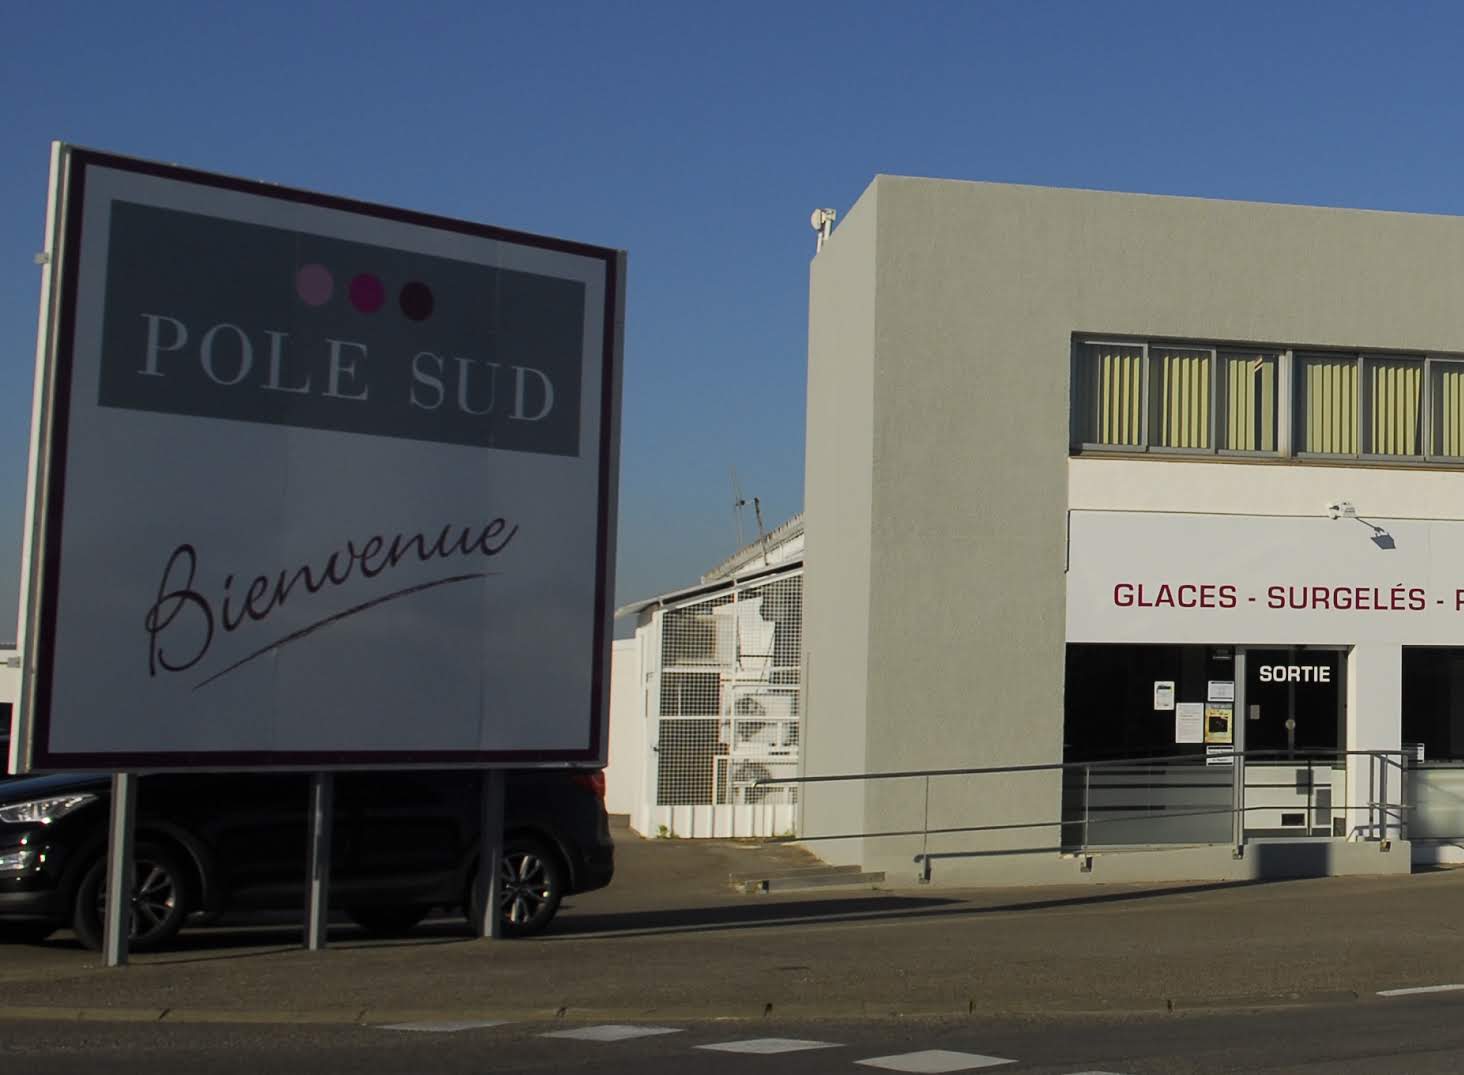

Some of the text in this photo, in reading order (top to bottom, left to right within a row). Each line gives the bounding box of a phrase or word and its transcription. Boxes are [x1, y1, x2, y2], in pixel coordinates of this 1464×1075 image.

[137, 313, 555, 422] POLE SUD
[145, 517, 518, 677] Bienvenue
[1113, 583, 1237, 608] GLACES
[1267, 583, 1426, 611] SURGELÉS
[1259, 665, 1331, 682] SORTIE
